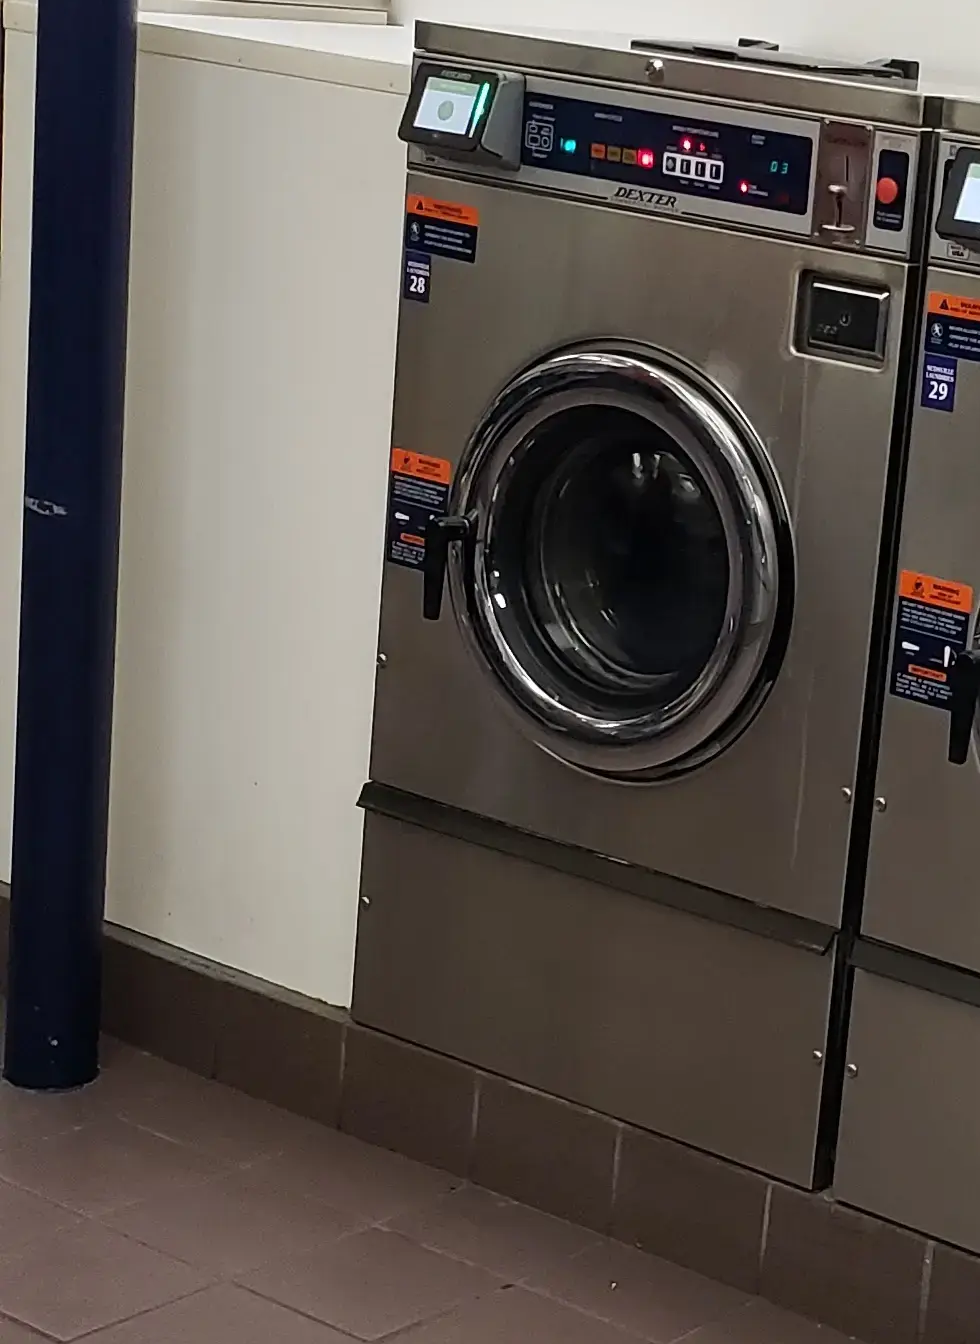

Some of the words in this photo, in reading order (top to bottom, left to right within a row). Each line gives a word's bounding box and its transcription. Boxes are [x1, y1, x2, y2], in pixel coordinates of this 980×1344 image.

[614, 187, 677, 208] DEXTER
[410, 275, 426, 294] 28
[928, 380, 948, 401] 29
